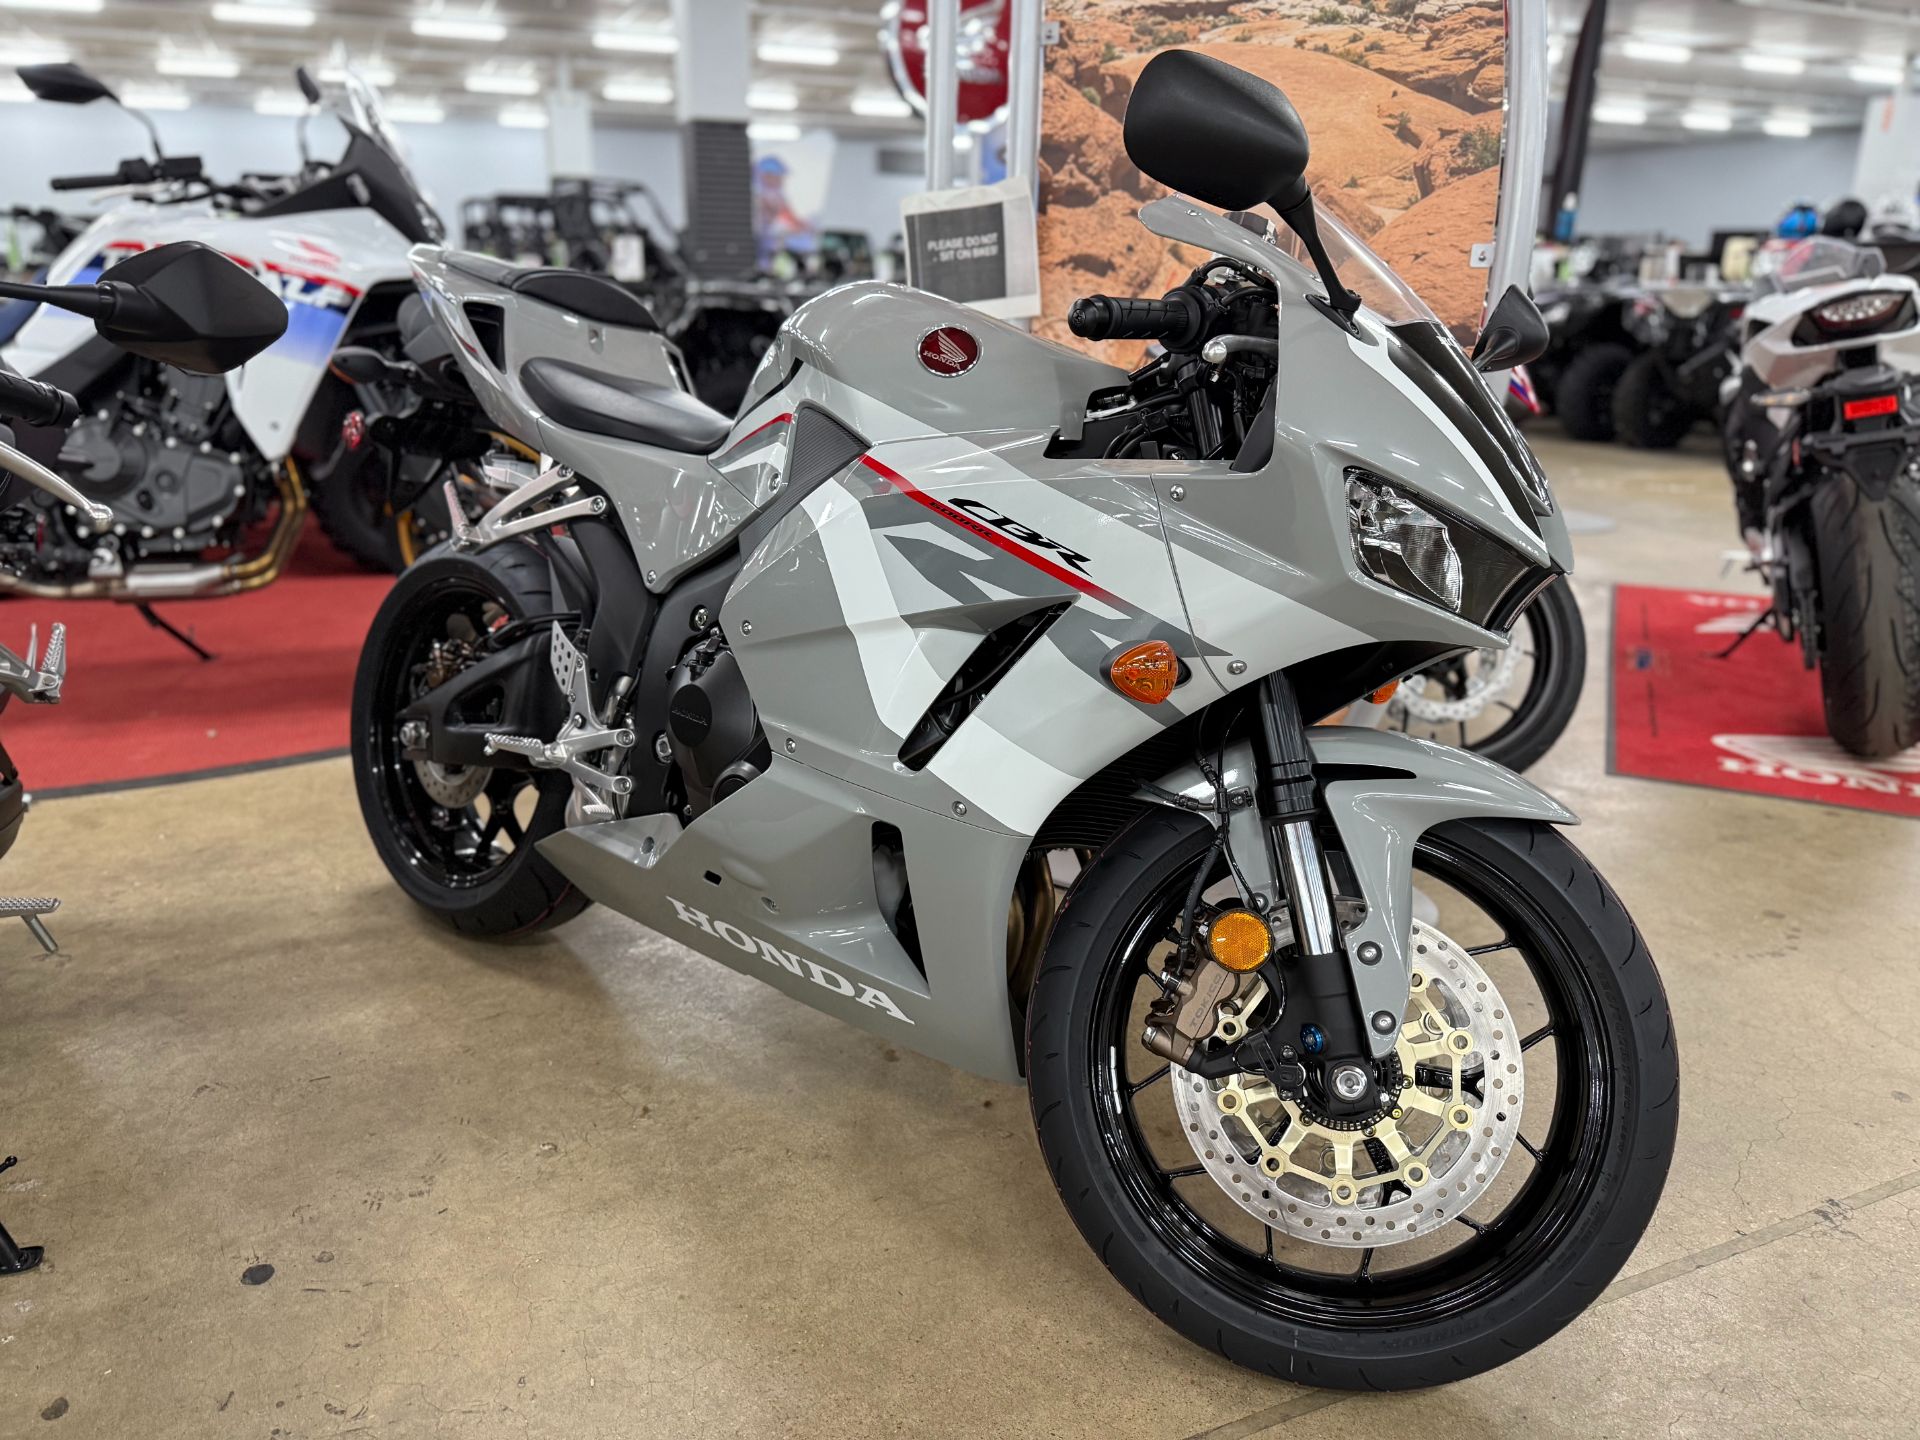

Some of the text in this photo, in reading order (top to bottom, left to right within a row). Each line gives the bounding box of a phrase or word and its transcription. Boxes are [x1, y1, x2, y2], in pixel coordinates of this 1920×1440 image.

[927, 232, 998, 252] PLEASE DO NOT
[940, 250, 955, 262] SIT
[956, 248, 972, 261] ON
[923, 350, 961, 370] HONDA
[929, 501, 993, 538] 600RR
[947, 497, 1093, 578] CBR
[665, 895, 915, 1025] HONDA
[1189, 973, 1222, 1027] TOKICO
